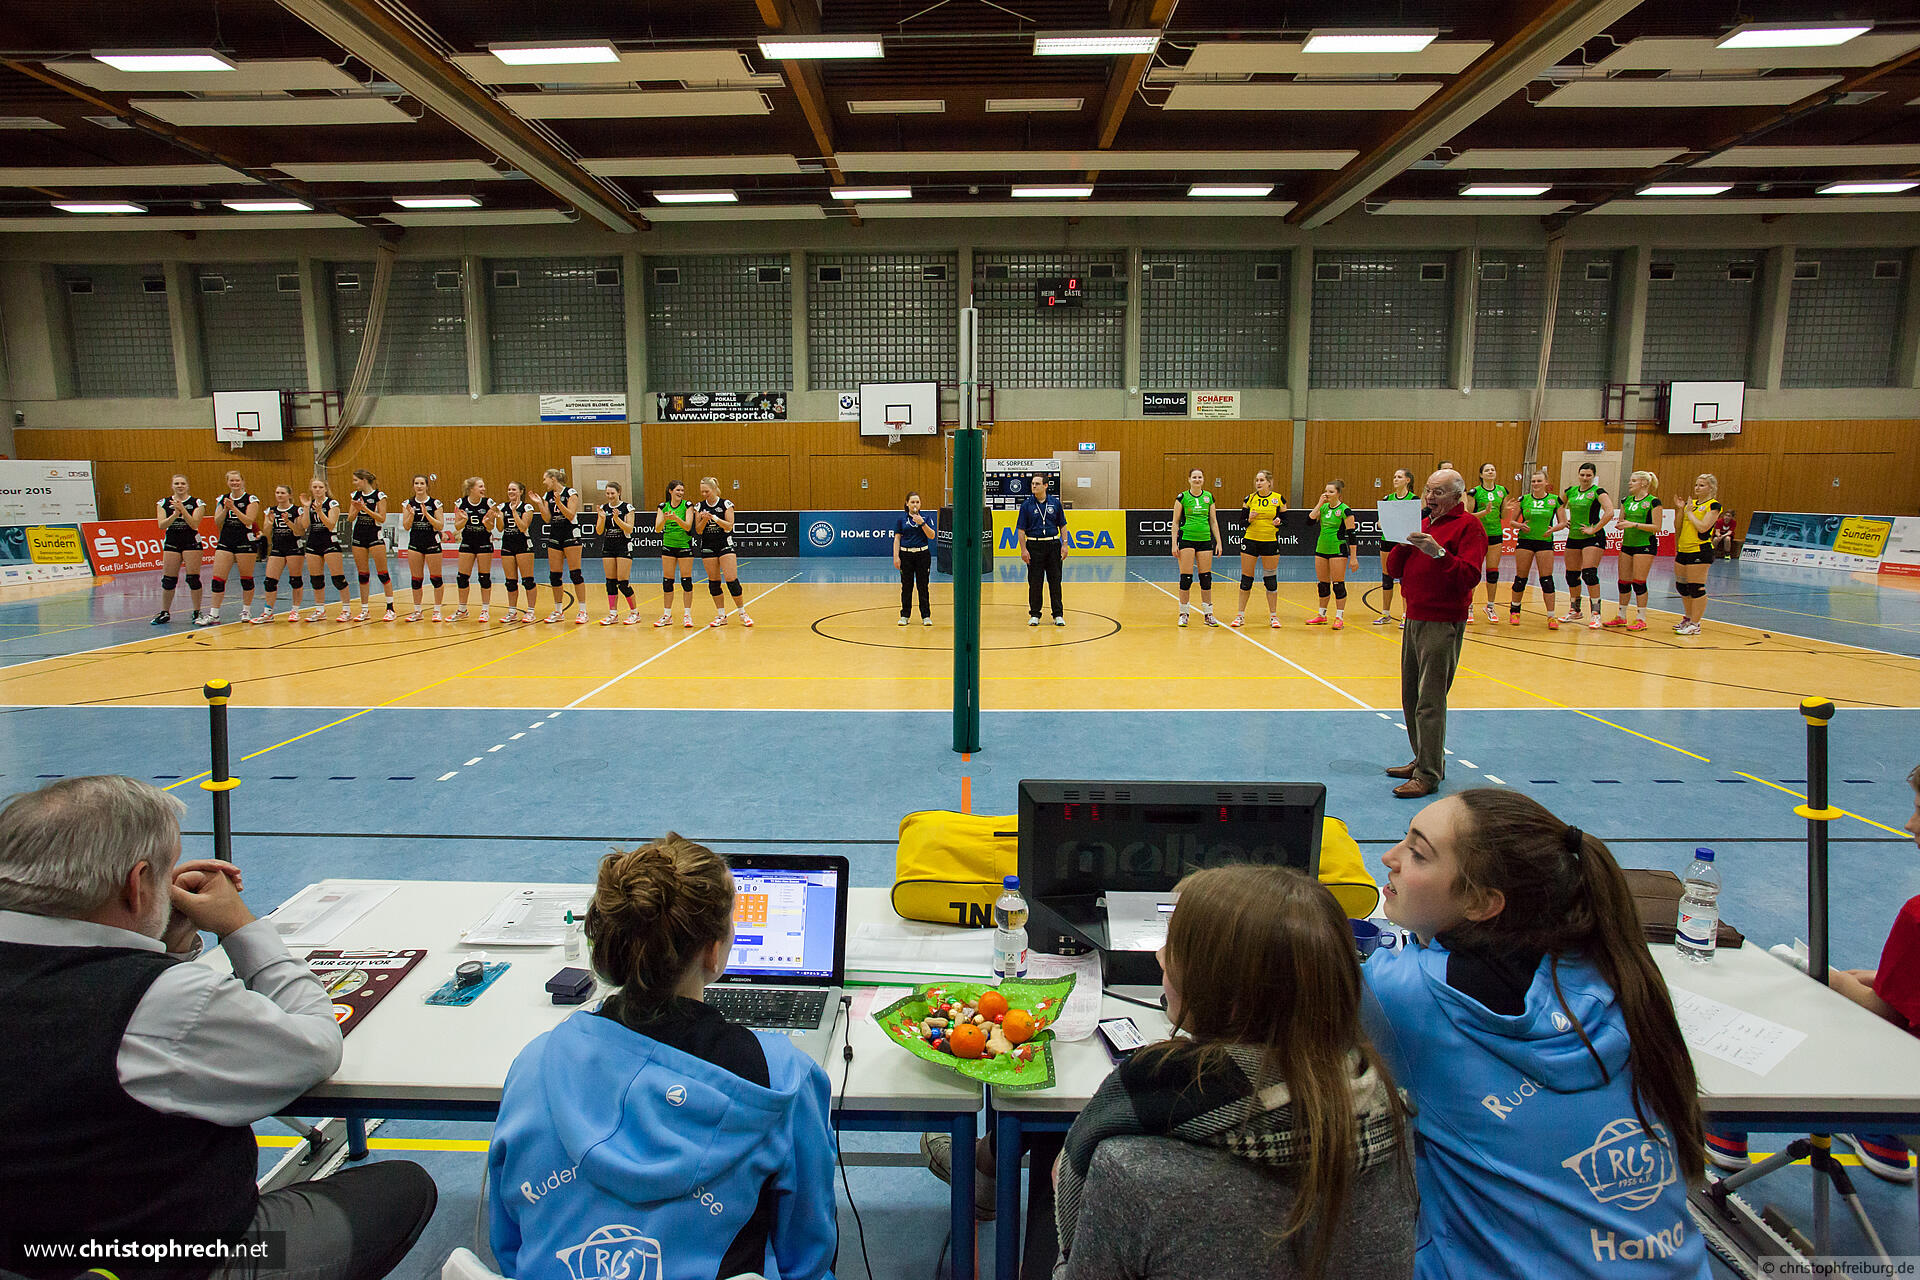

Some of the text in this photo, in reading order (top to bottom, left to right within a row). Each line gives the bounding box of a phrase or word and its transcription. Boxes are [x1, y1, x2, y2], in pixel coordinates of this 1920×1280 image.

[1070, 280, 1076, 289] 0
[1049, 296, 1055, 306] 0
[1144, 396, 1186, 404] blomus
[670, 412, 775, 421] www.wipo-sport.de
[1488, 492, 1494, 501] 8
[1194, 498, 1202, 508] 1
[1258, 499, 1269, 507] 10
[1532, 500, 1544, 508] 12
[1628, 502, 1640, 512] 16
[470, 516, 480, 524] 6
[508, 518, 516, 528] 5
[733, 522, 786, 534] caso
[1140, 521, 1173, 532] cas
[1842, 528, 1881, 542] Sundern
[34, 538, 76, 548] Sundern
[121, 534, 218, 559] Sparse
[100, 564, 113, 572] Gut
[114, 562, 124, 572] für
[124, 560, 155, 570] Sundern,
[1608, 1144, 1655, 1180] RCS
